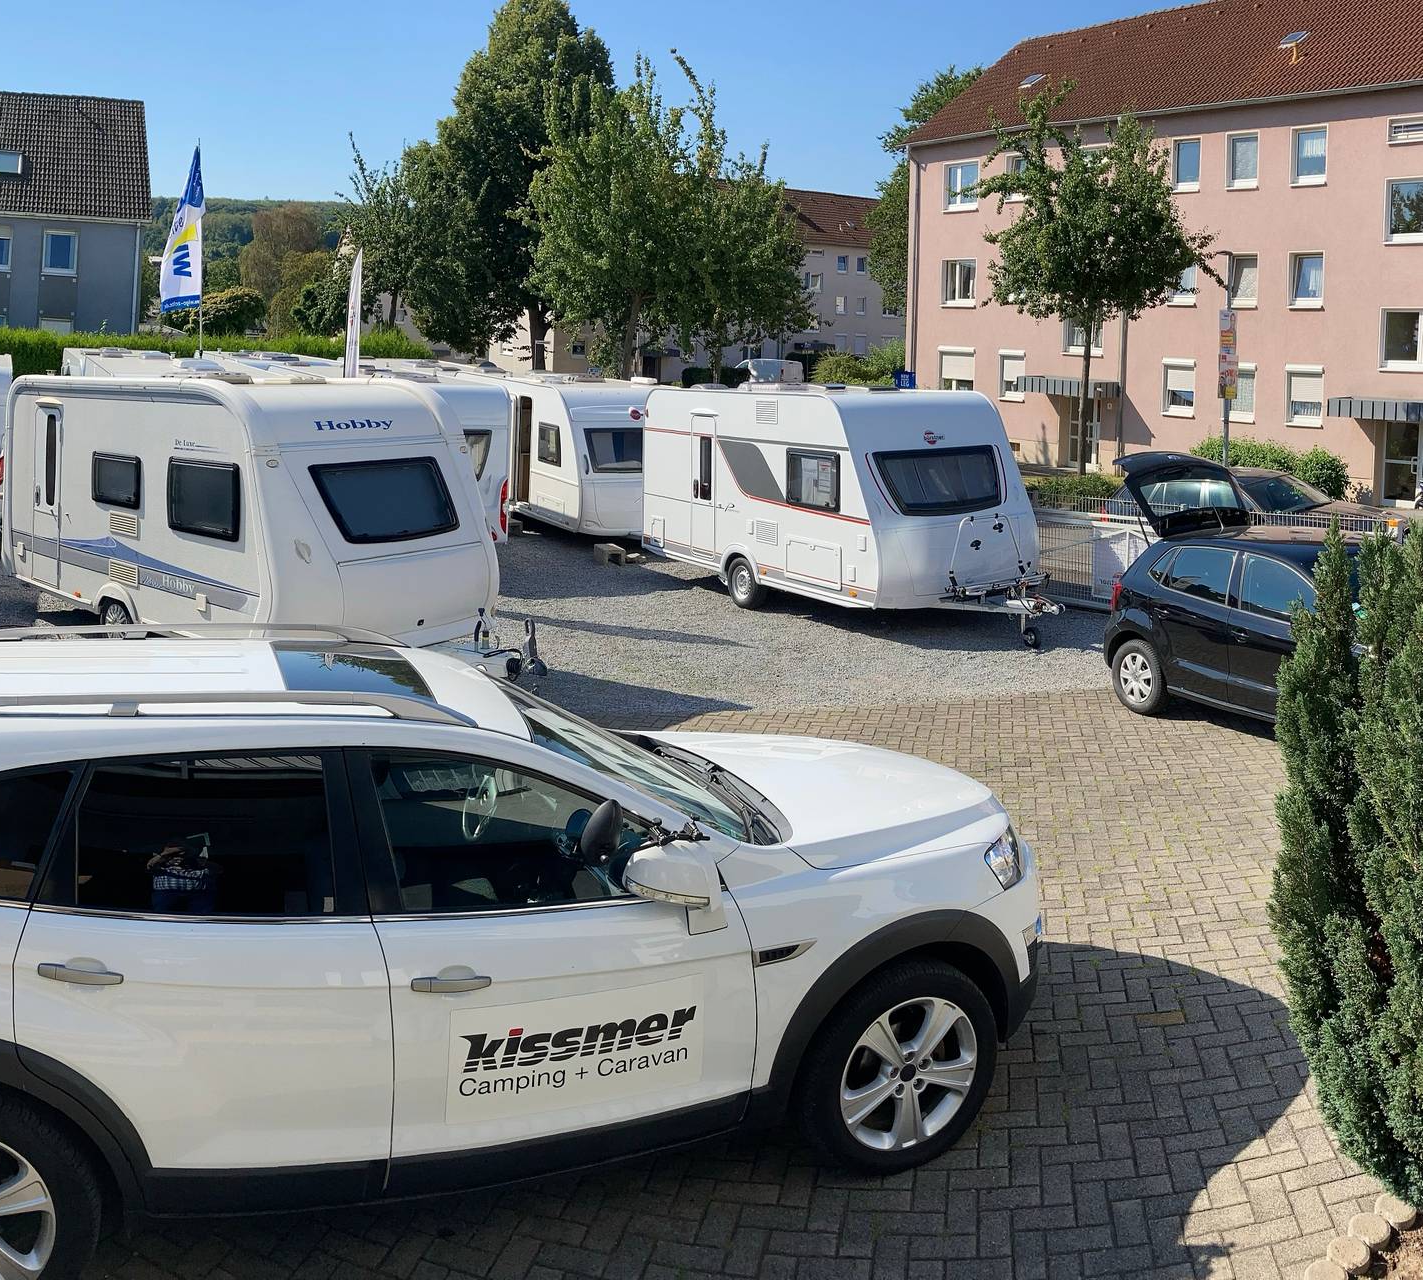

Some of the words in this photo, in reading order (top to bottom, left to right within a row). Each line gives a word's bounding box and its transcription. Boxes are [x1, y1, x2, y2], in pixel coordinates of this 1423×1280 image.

[313, 419, 393, 431] Hobby
[162, 575, 195, 594] Hobby
[458, 1005, 697, 1073] kissmer
[459, 1068, 567, 1096] Camping
[575, 1066, 589, 1080] +
[597, 1046, 689, 1077] Caravan
